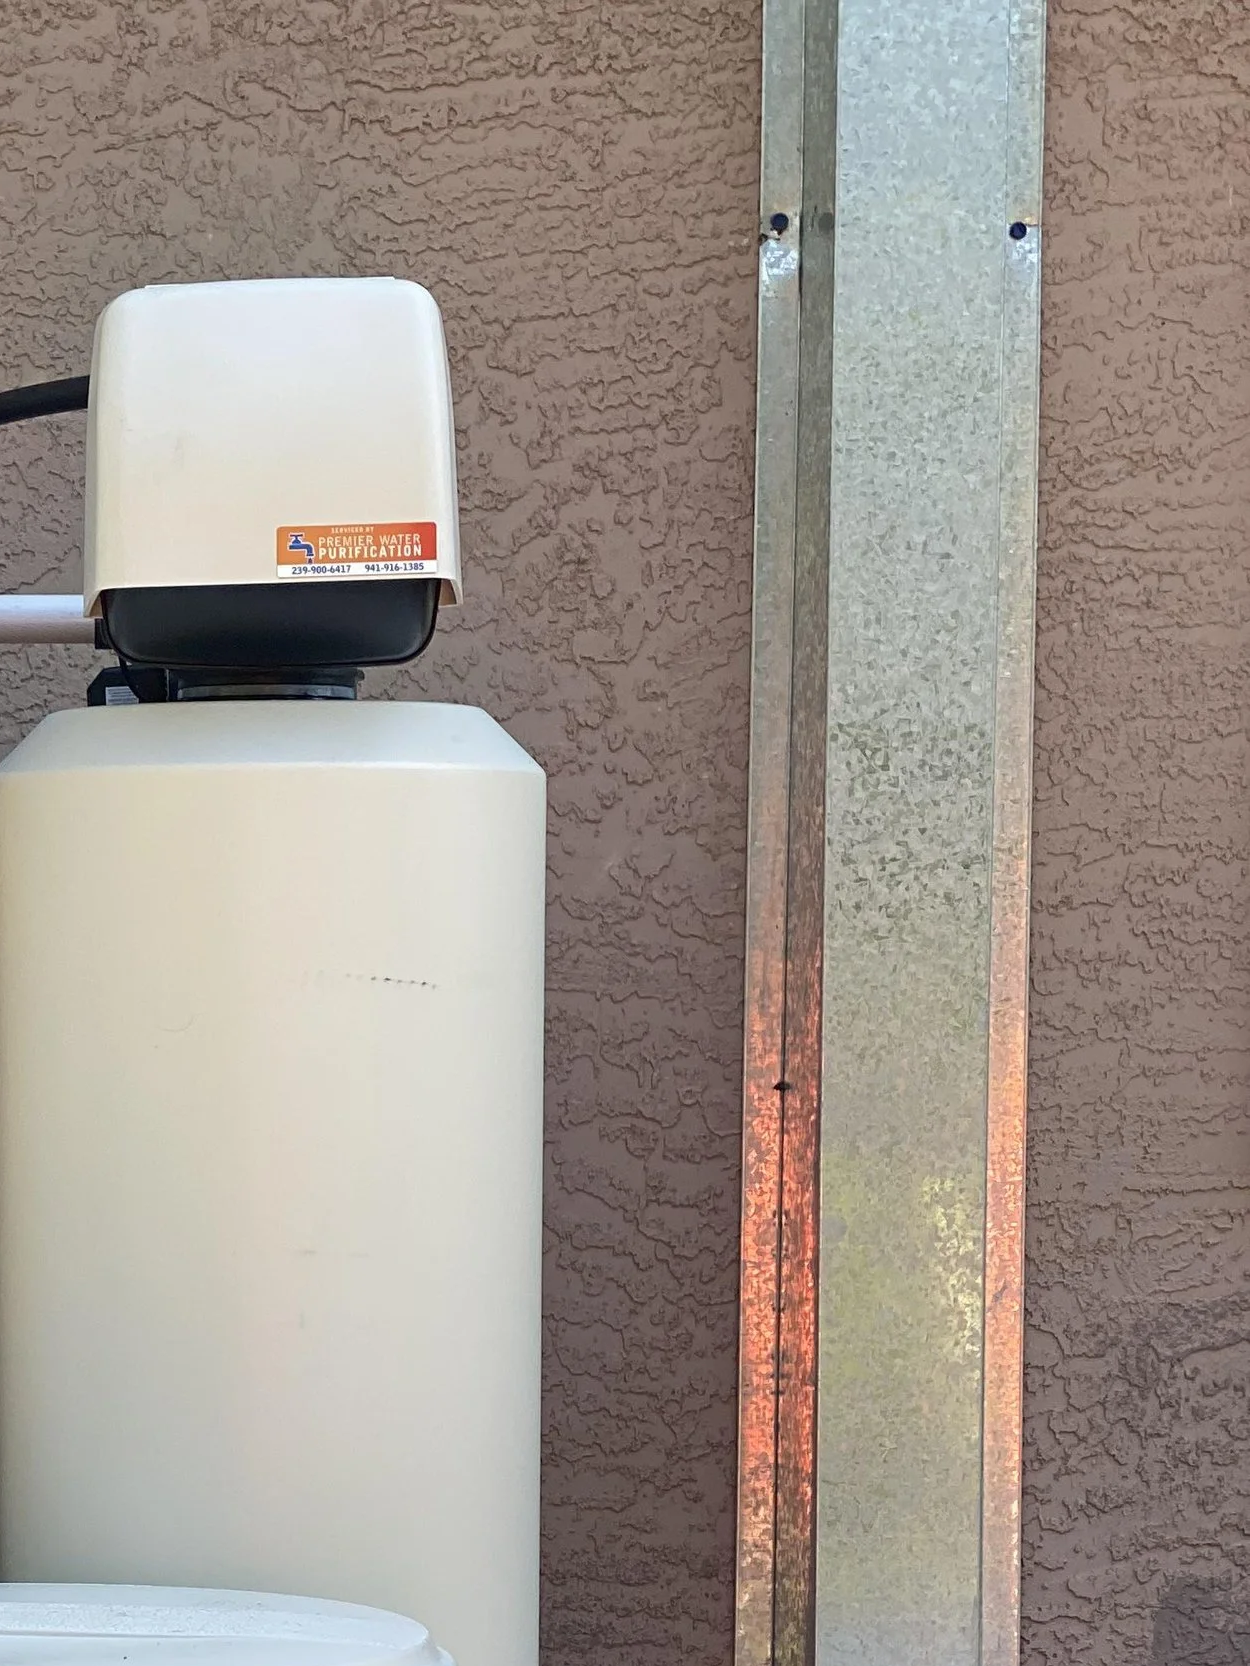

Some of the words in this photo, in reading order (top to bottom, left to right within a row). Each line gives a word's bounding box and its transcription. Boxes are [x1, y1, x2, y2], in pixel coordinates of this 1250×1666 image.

[318, 535, 374, 547] PREMIER
[379, 533, 420, 545] WATER
[318, 544, 422, 560] PURIFICATION
[291, 564, 351, 575] 239-900-6417
[364, 562, 424, 572] 941-916-1385
